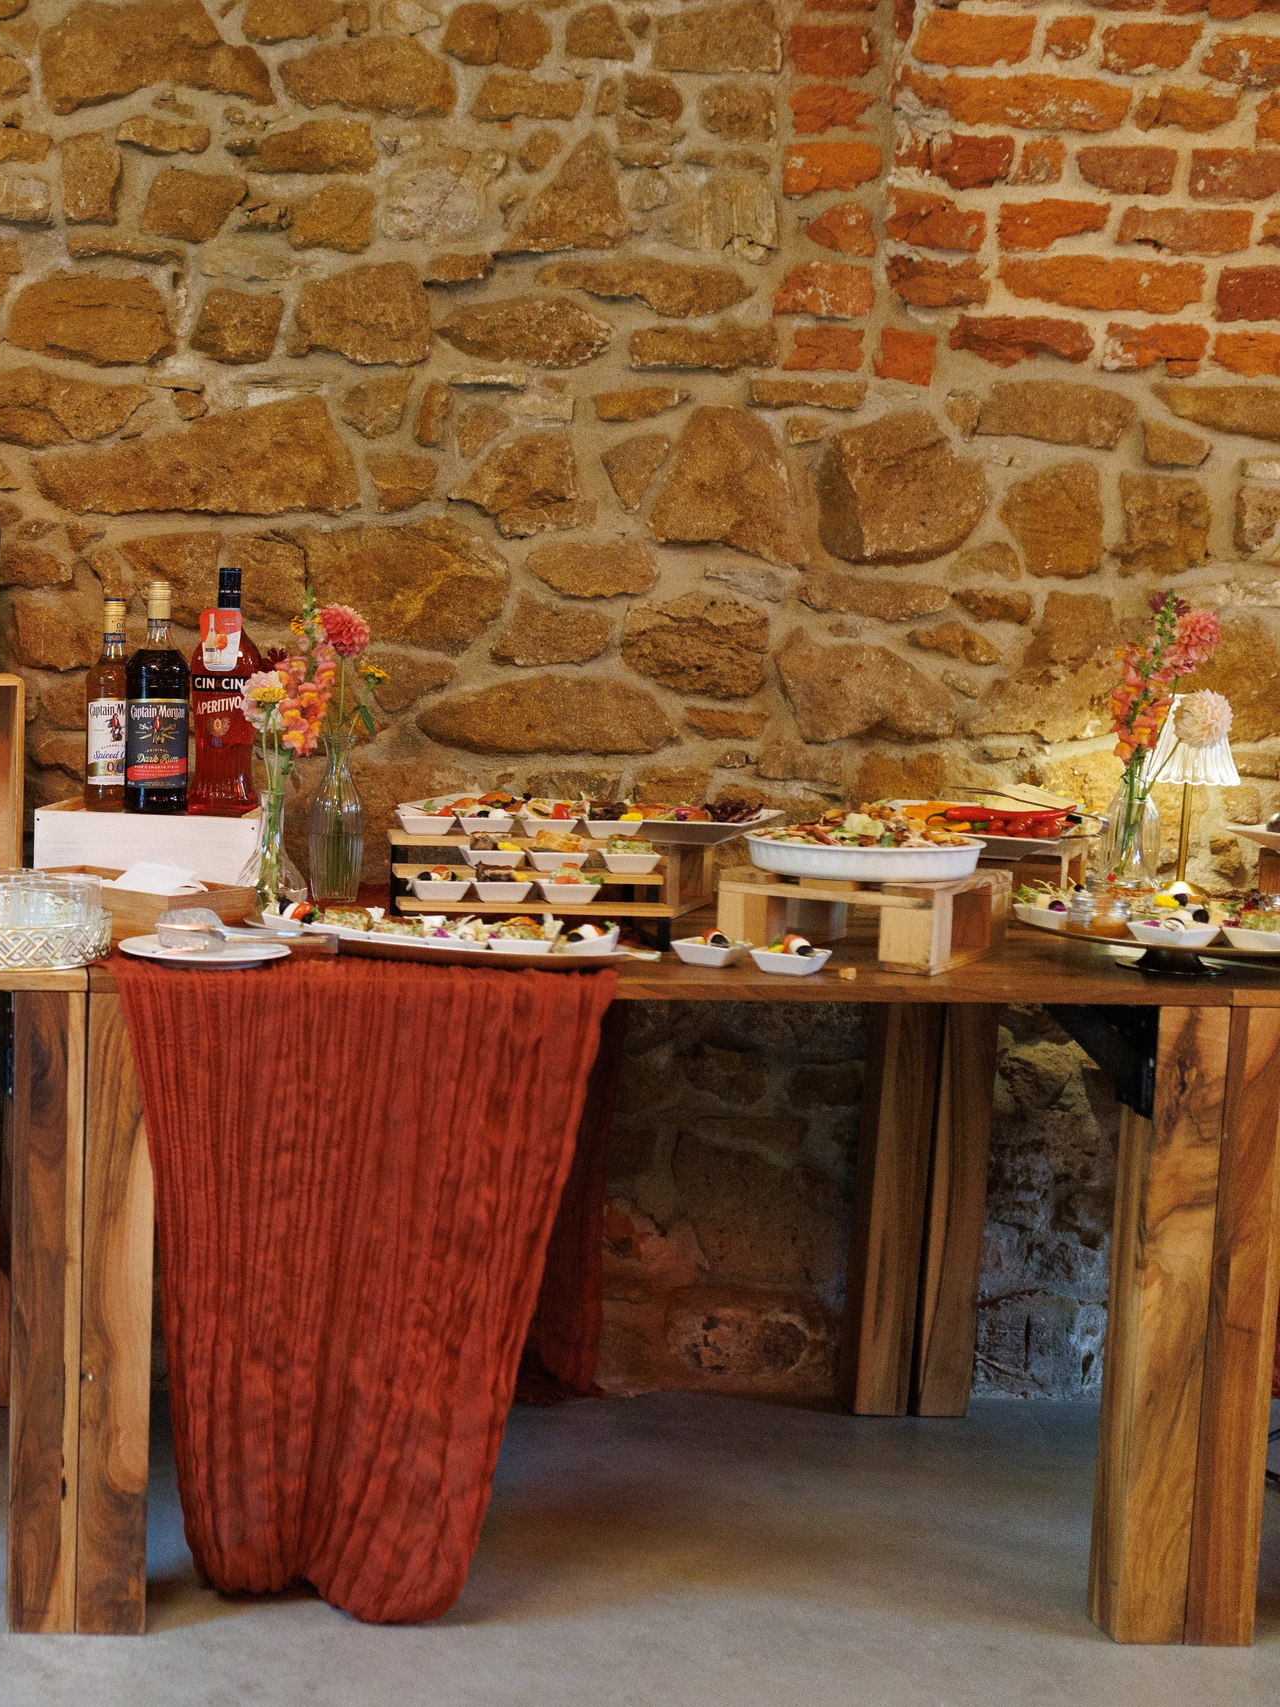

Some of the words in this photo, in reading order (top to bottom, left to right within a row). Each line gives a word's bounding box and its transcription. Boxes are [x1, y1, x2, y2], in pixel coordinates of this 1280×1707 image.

[195, 677, 215, 689] CIN
[221, 678, 244, 690] CIN
[89, 703, 115, 718] Captain
[130, 705, 155, 720] Captain
[157, 704, 186, 720] Morgan
[196, 695, 242, 715] APERITIVO
[93, 750, 119, 760] Spiced
[136, 752, 159, 763] Dark
[160, 753, 179, 764] Rum
